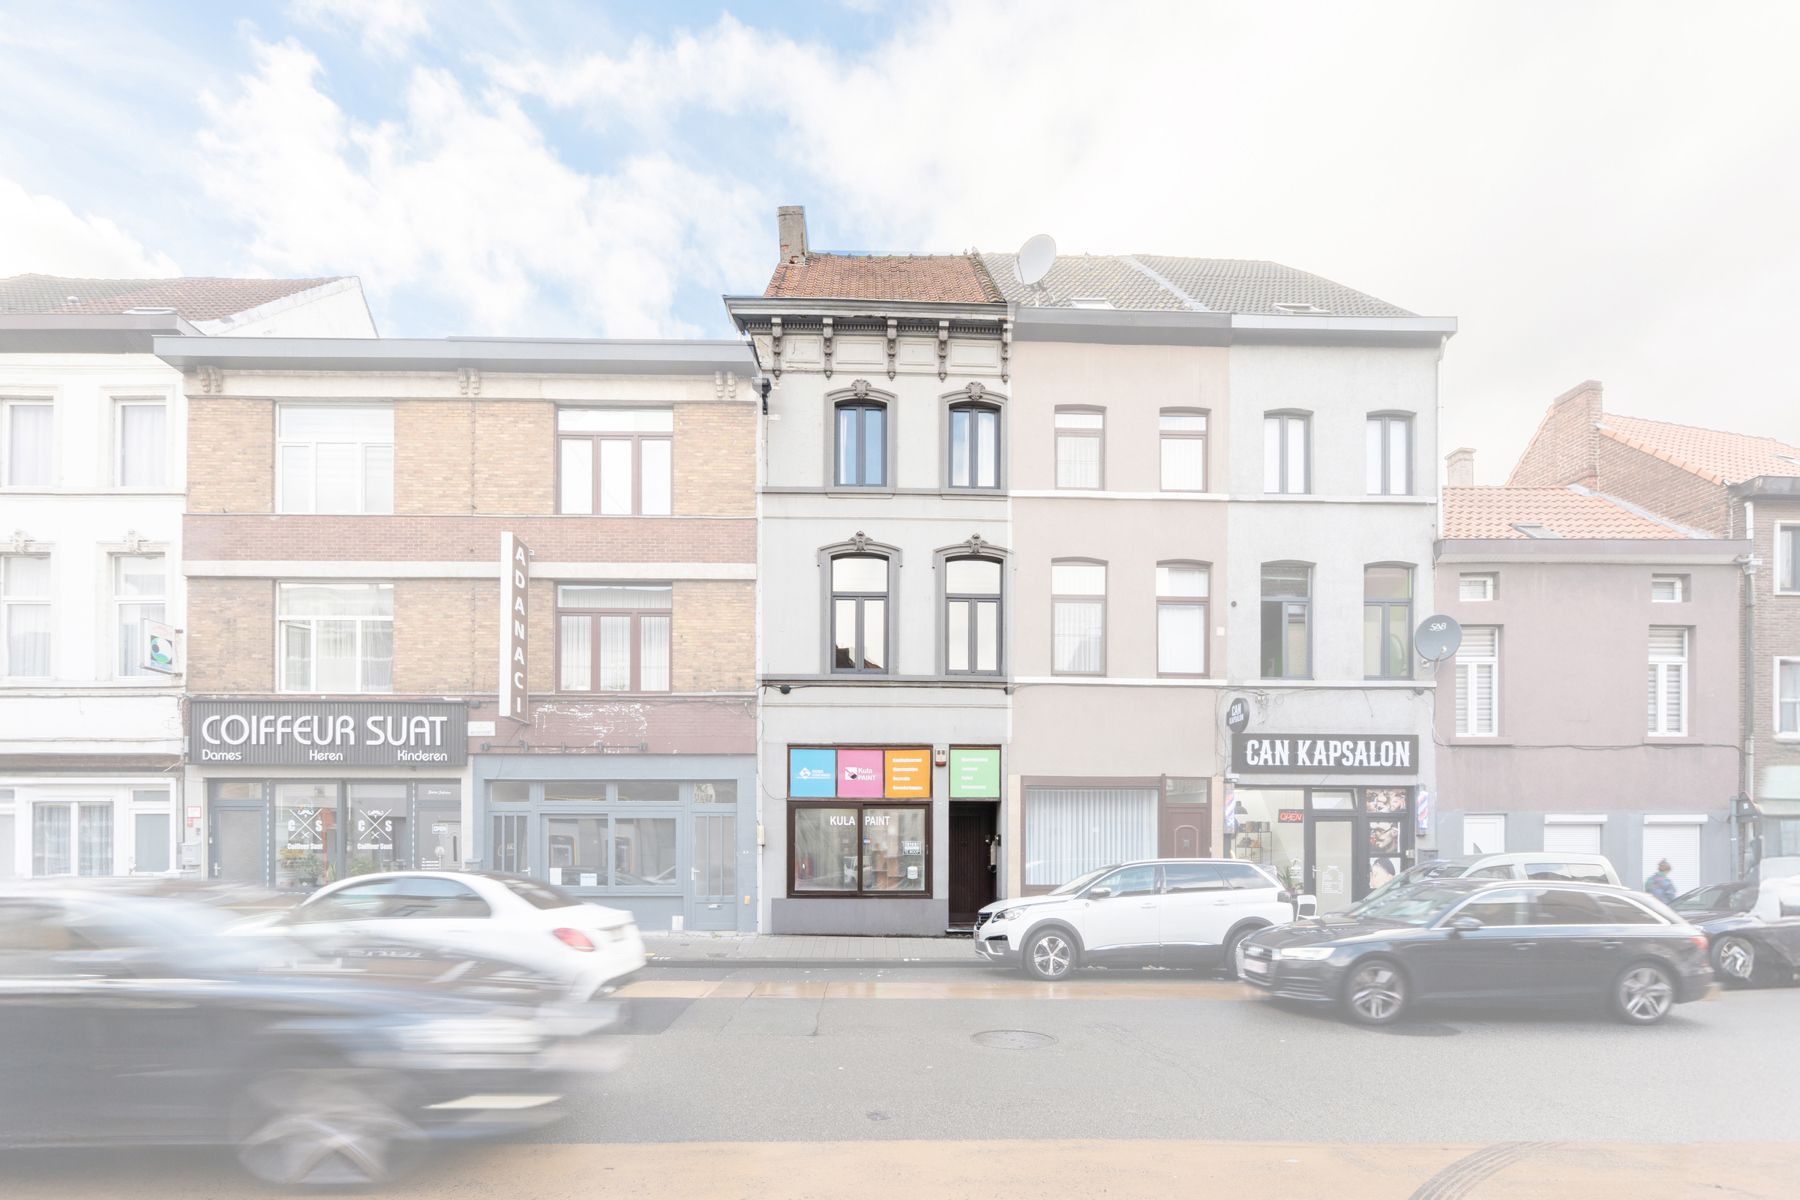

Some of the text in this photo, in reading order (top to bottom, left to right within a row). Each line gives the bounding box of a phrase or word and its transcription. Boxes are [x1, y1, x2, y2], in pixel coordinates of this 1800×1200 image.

[514, 546, 526, 713] ADANACI
[1231, 703, 1242, 717] CAN
[201, 714, 448, 746] COIFFEUR SUAT
[202, 749, 448, 762] Dames Heren Kinderen
[1246, 739, 1411, 767] CAN KAPSALON
[829, 815, 890, 826] KULA PAINT
[1280, 812, 1303, 821] OPEN
[288, 819, 323, 832] C S
[357, 819, 392, 832] C S
